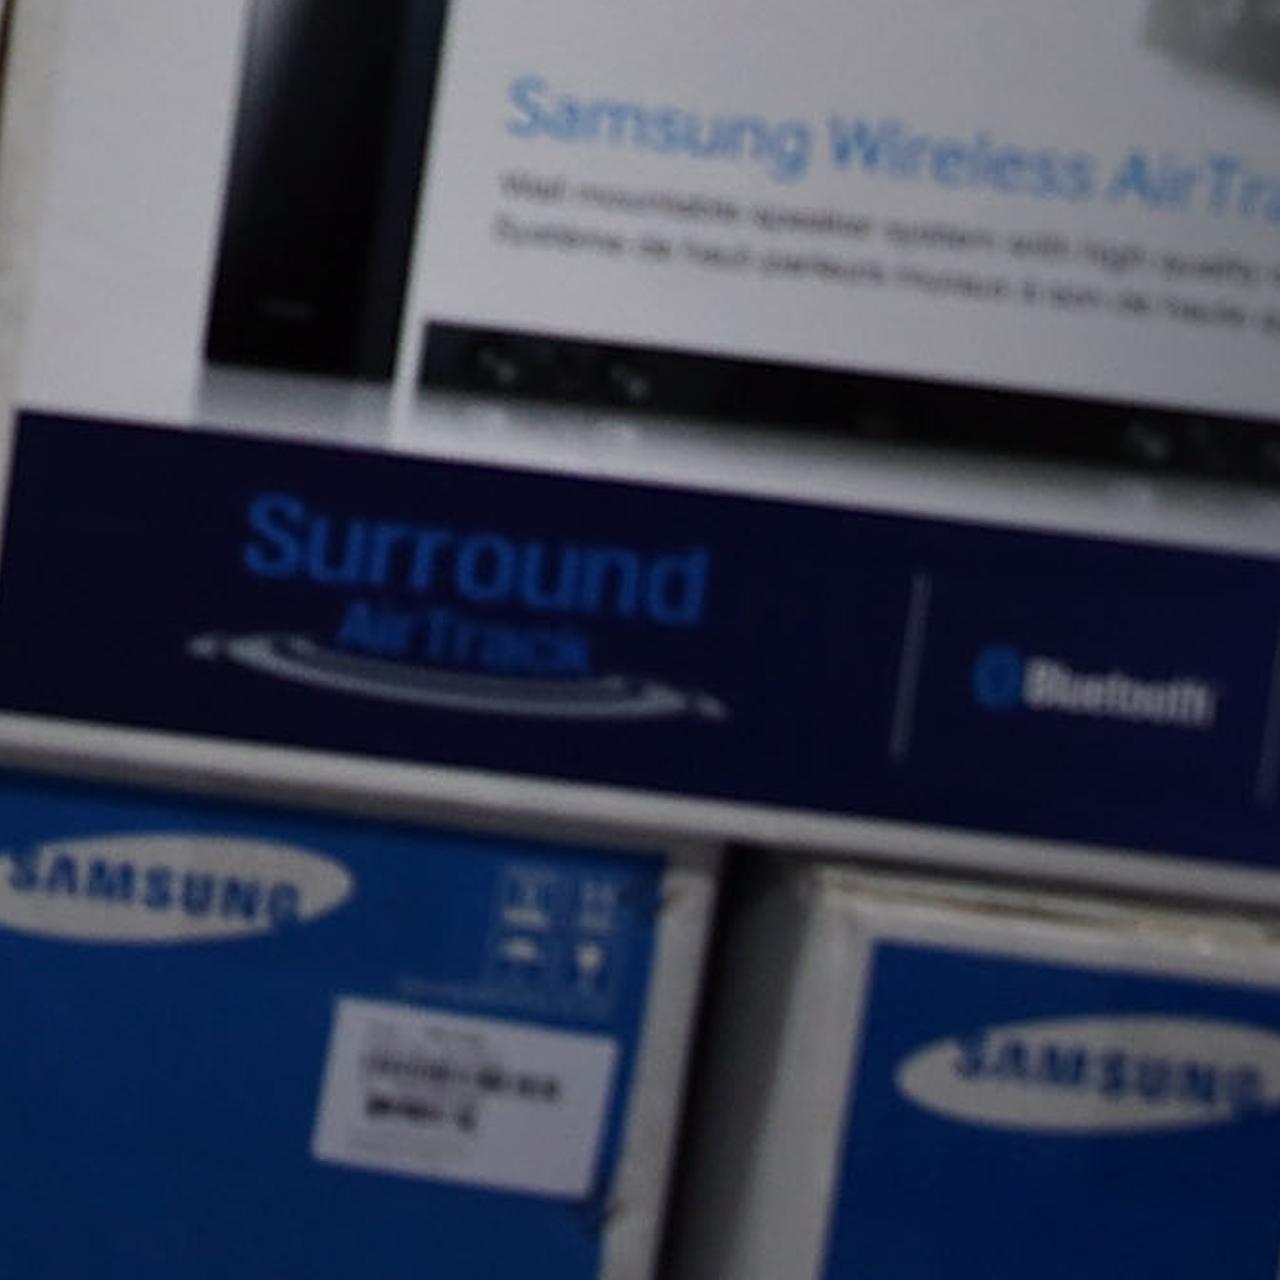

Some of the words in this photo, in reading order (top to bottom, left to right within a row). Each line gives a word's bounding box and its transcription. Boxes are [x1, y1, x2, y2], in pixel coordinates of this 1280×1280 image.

[505, 70, 810, 188] Samsung
[827, 112, 1097, 203] Wireless
[1112, 149, 1280, 227] AirTra
[240, 490, 711, 630] Surround
[1022, 656, 1219, 727] Bluetooth
[8, 848, 303, 929] SAMSUNG
[952, 1038, 1266, 1117] SAMSUNG
